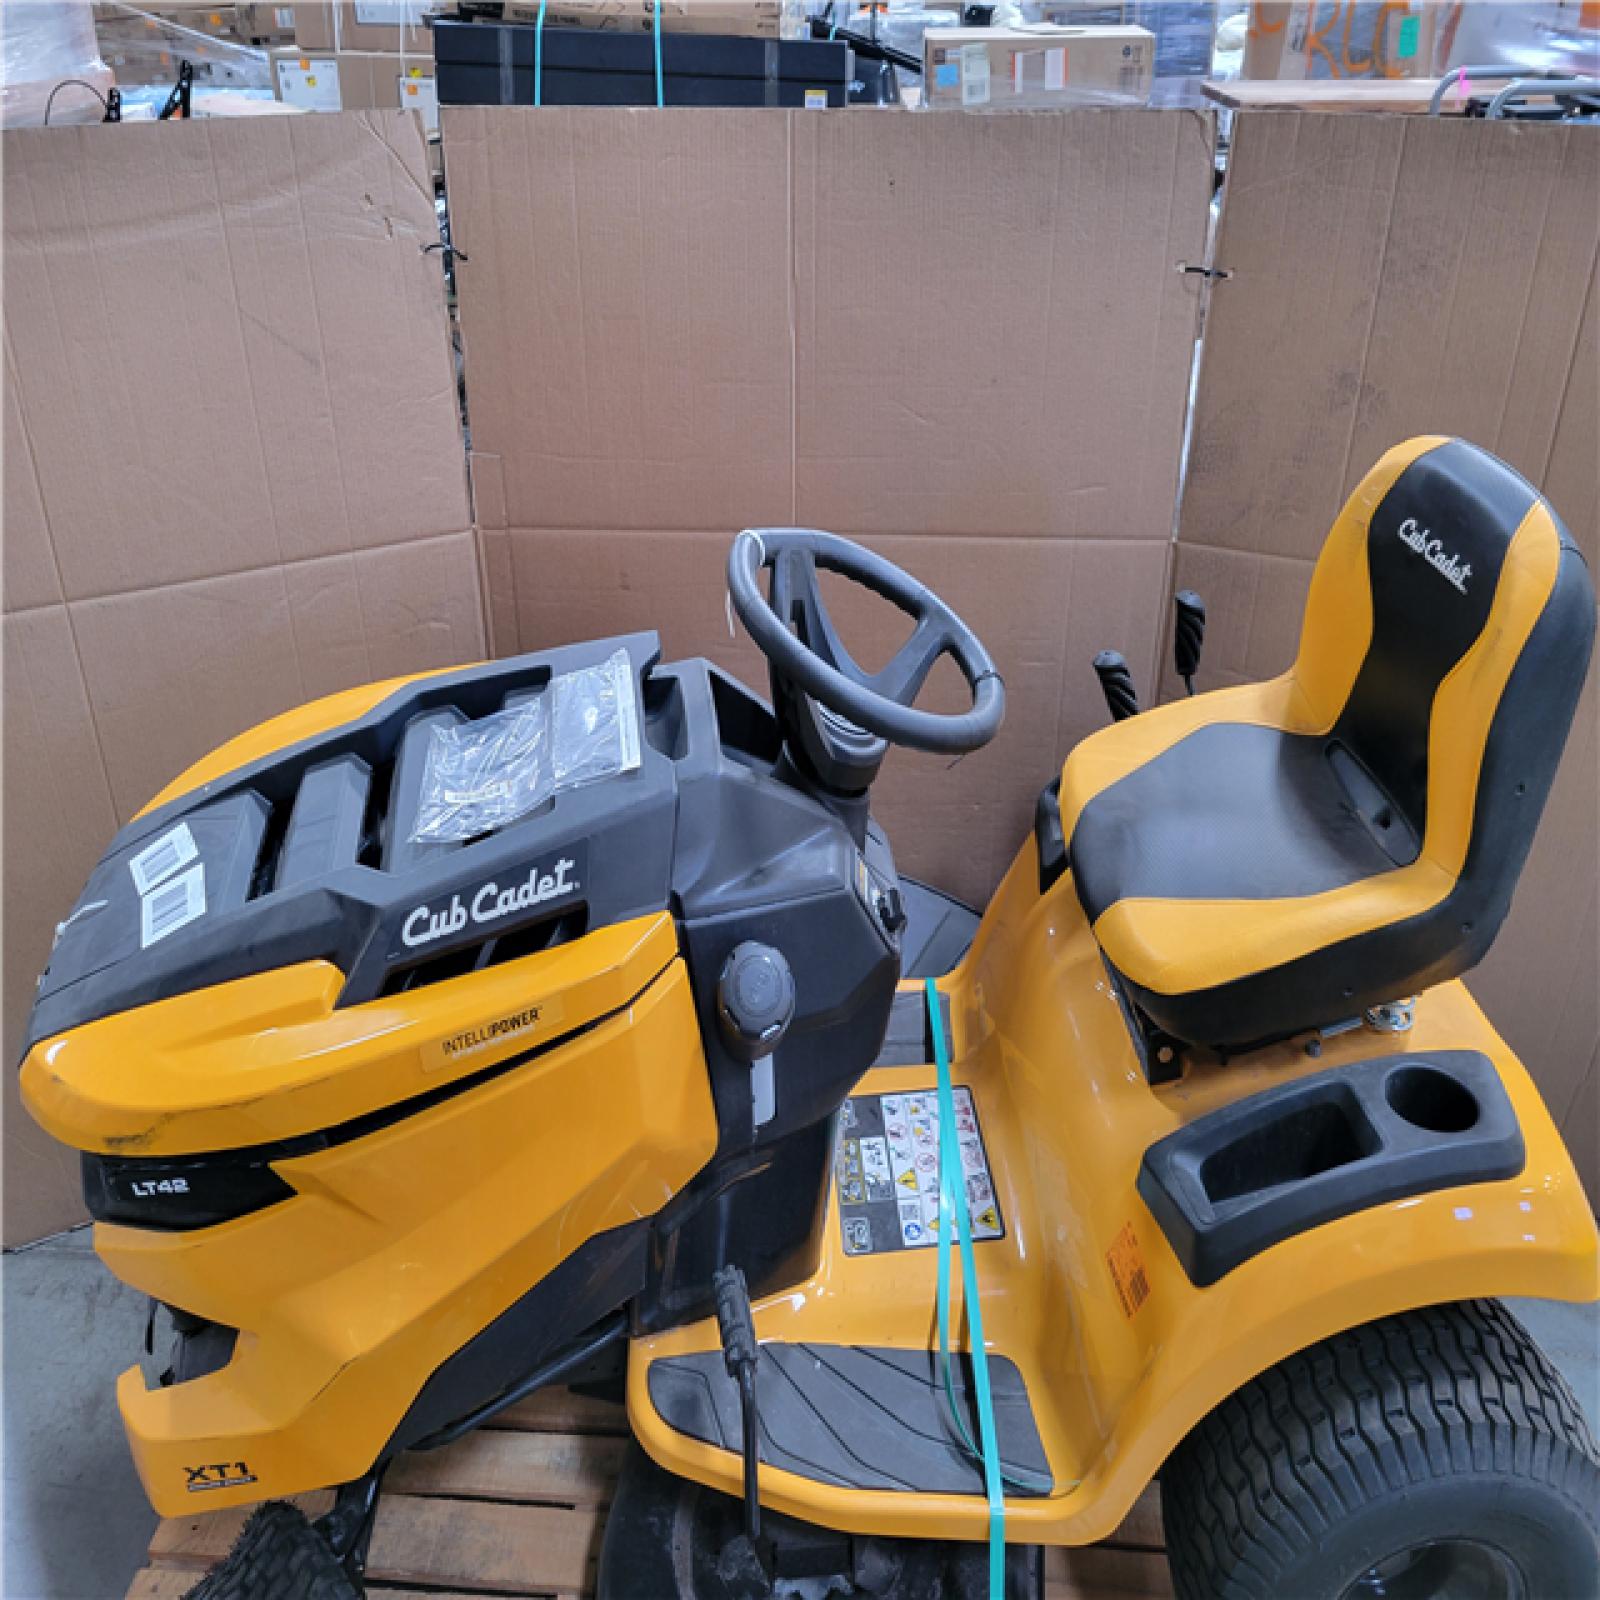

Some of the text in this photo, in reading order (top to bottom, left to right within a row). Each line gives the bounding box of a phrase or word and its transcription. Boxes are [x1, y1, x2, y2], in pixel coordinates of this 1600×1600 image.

[1398, 517, 1472, 595] Cub Cadet
[402, 857, 576, 947] Cub Cadet
[442, 1005, 540, 1055] INTELLIPOWER
[131, 1177, 190, 1197] LT42
[183, 1462, 250, 1481] XT1
